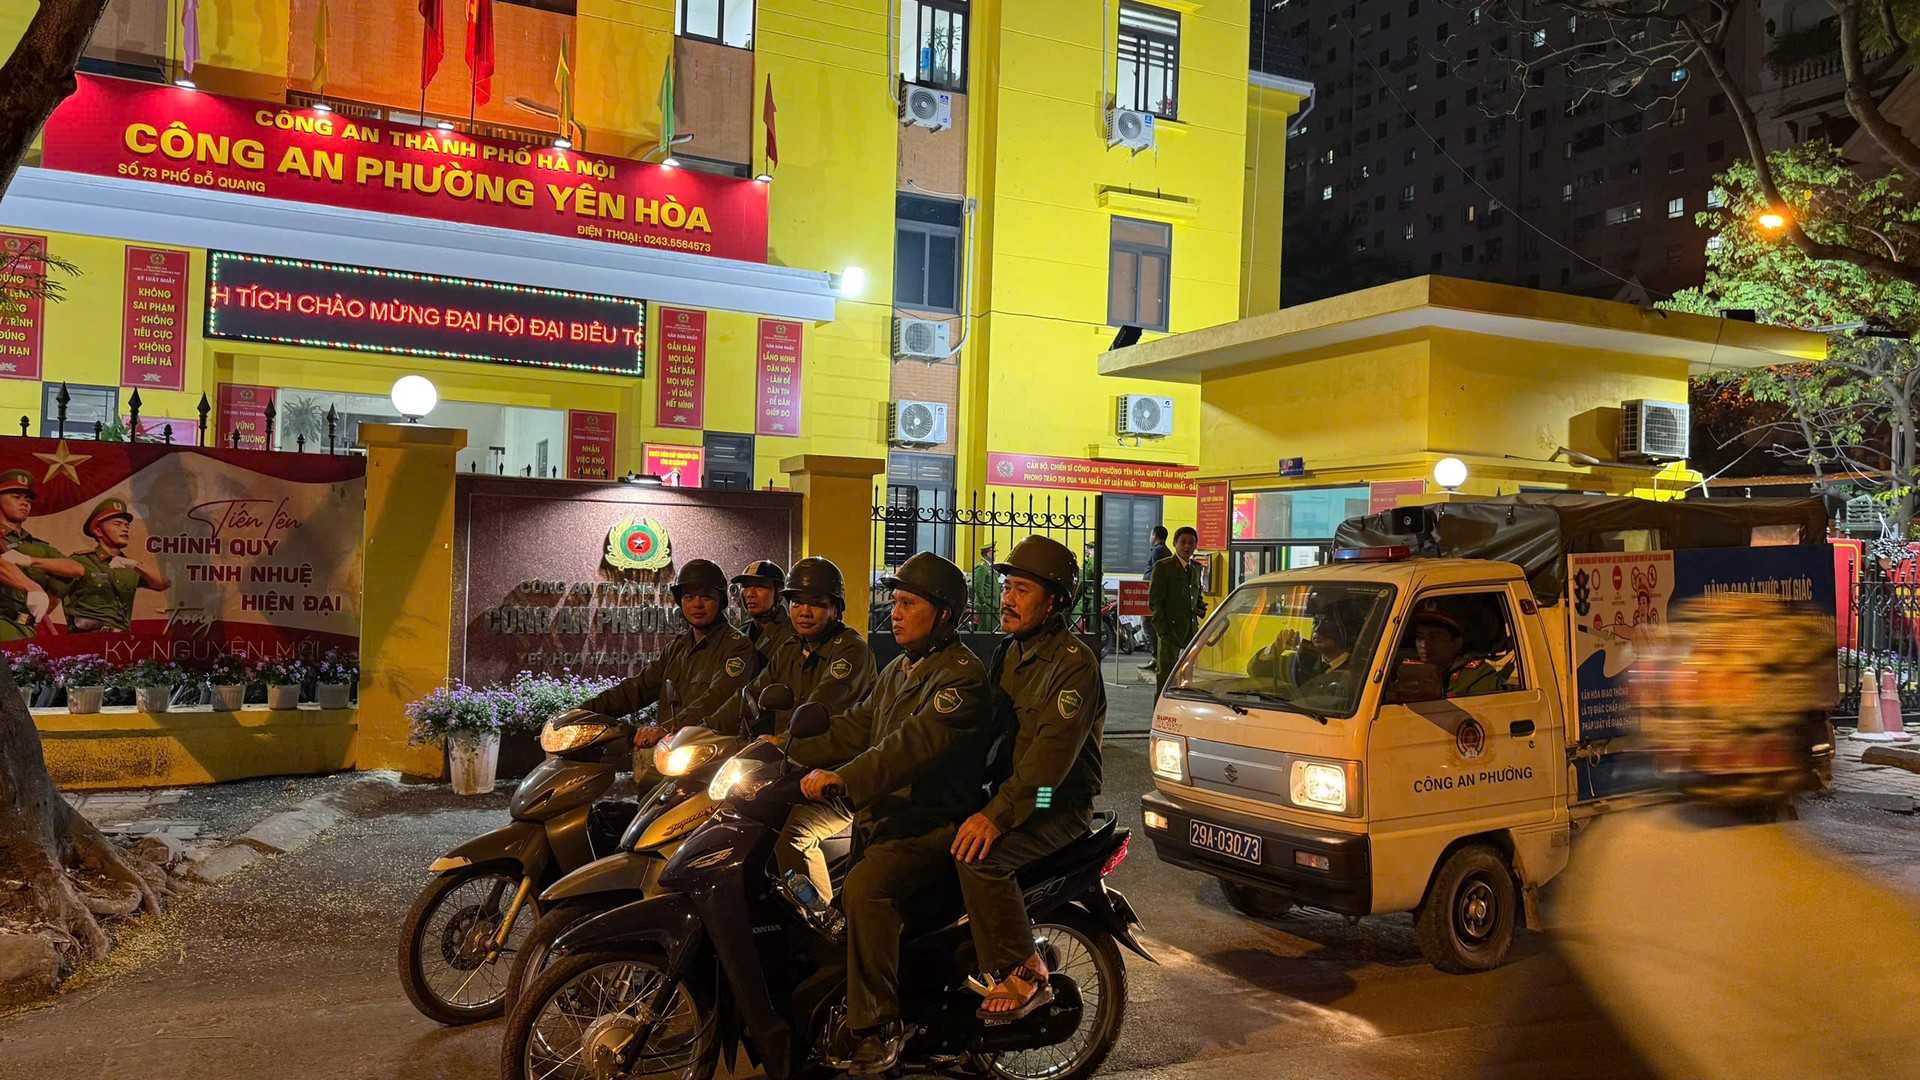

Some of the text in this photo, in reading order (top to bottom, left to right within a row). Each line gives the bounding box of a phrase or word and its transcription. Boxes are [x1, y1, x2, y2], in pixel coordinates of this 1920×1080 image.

[255, 109, 616, 181] CÔNG AN THÀNH PHỐ HÀ NỘI
[118, 160, 266, 192] SỐ 73 PHỐ ĐỖ QUANG
[125, 120, 712, 233] CÔNG AN PHƯỜNG YÊN HÒA
[577, 224, 711, 252] ĐIỆN THOẠI: 0243.5564573
[138, 287, 172, 299] KHÔNG
[133, 300, 176, 315] SAI PHẠM
[235, 283, 293, 312] TÍCH
[297, 292, 365, 318] CHÀO
[369, 298, 441, 325] MỪNG
[445, 309, 481, 332] ĐẠI
[487, 313, 524, 337] HỘI
[529, 317, 564, 341] ĐẠI
[570, 320, 617, 344] BIỂU
[141, 314, 174, 327] KHÔNG
[133, 326, 173, 341] TIÊU CỰC
[10, 346, 30, 358] HẠN
[138, 341, 172, 353] KHÔNG
[682, 342, 696, 353] DÂN
[131, 353, 173, 367] PHIỀN HÀ
[668, 353, 694, 365] MỌI LÚC
[779, 354, 796, 363] NGHE
[669, 365, 695, 376] SÁT DÂN
[766, 364, 791, 374] DÂN NÓI
[666, 377, 695, 389] MỌI VIỆC
[770, 374, 782, 384] LÀM
[671, 387, 692, 398] VÌ DÂN
[767, 386, 790, 396] DÂN TIN
[665, 398, 694, 410] HẾT MÌNH
[777, 397, 790, 406] DÂN
[765, 407, 779, 417] GIÚP
[576, 455, 605, 465] VIỆC KHÓ
[1073, 464, 1090, 473] CÔNG
[1091, 465, 1099, 473] AN
[1123, 467, 1132, 476] YÊN
[1133, 468, 1146, 476] HÒA
[1146, 468, 1162, 477] QUYẾT
[1023, 473, 1043, 482] PHONG
[1043, 473, 1058, 482] TRÀO
[1058, 475, 1066, 483] THI
[1111, 478, 1123, 488] LUẬT
[1123, 478, 1137, 487] NHẤT
[1140, 481, 1156, 489] TRUNG
[1156, 481, 1173, 490] THÀNH
[1173, 481, 1186, 490] NHẤT
[187, 497, 303, 543] Tiến lên
[145, 533, 280, 557] CHÍNH QUY
[186, 562, 313, 588] TINH NHUỆ
[519, 578, 656, 596] CÔNG AN THÀNH
[1792, 573, 1813, 601] GIÁC
[241, 591, 342, 616] HIỆN ĐẠI
[156, 604, 218, 638] Trong
[483, 599, 553, 635] CÔNG
[557, 606, 591, 634] AN
[104, 634, 142, 661] KỶ
[152, 635, 264, 662] NGUYÊN
[1156, 714, 1177, 723] SUPER
[1413, 765, 1533, 793] CÔNG AN PHƯỜNG
[751, 924, 782, 934] ONDA
